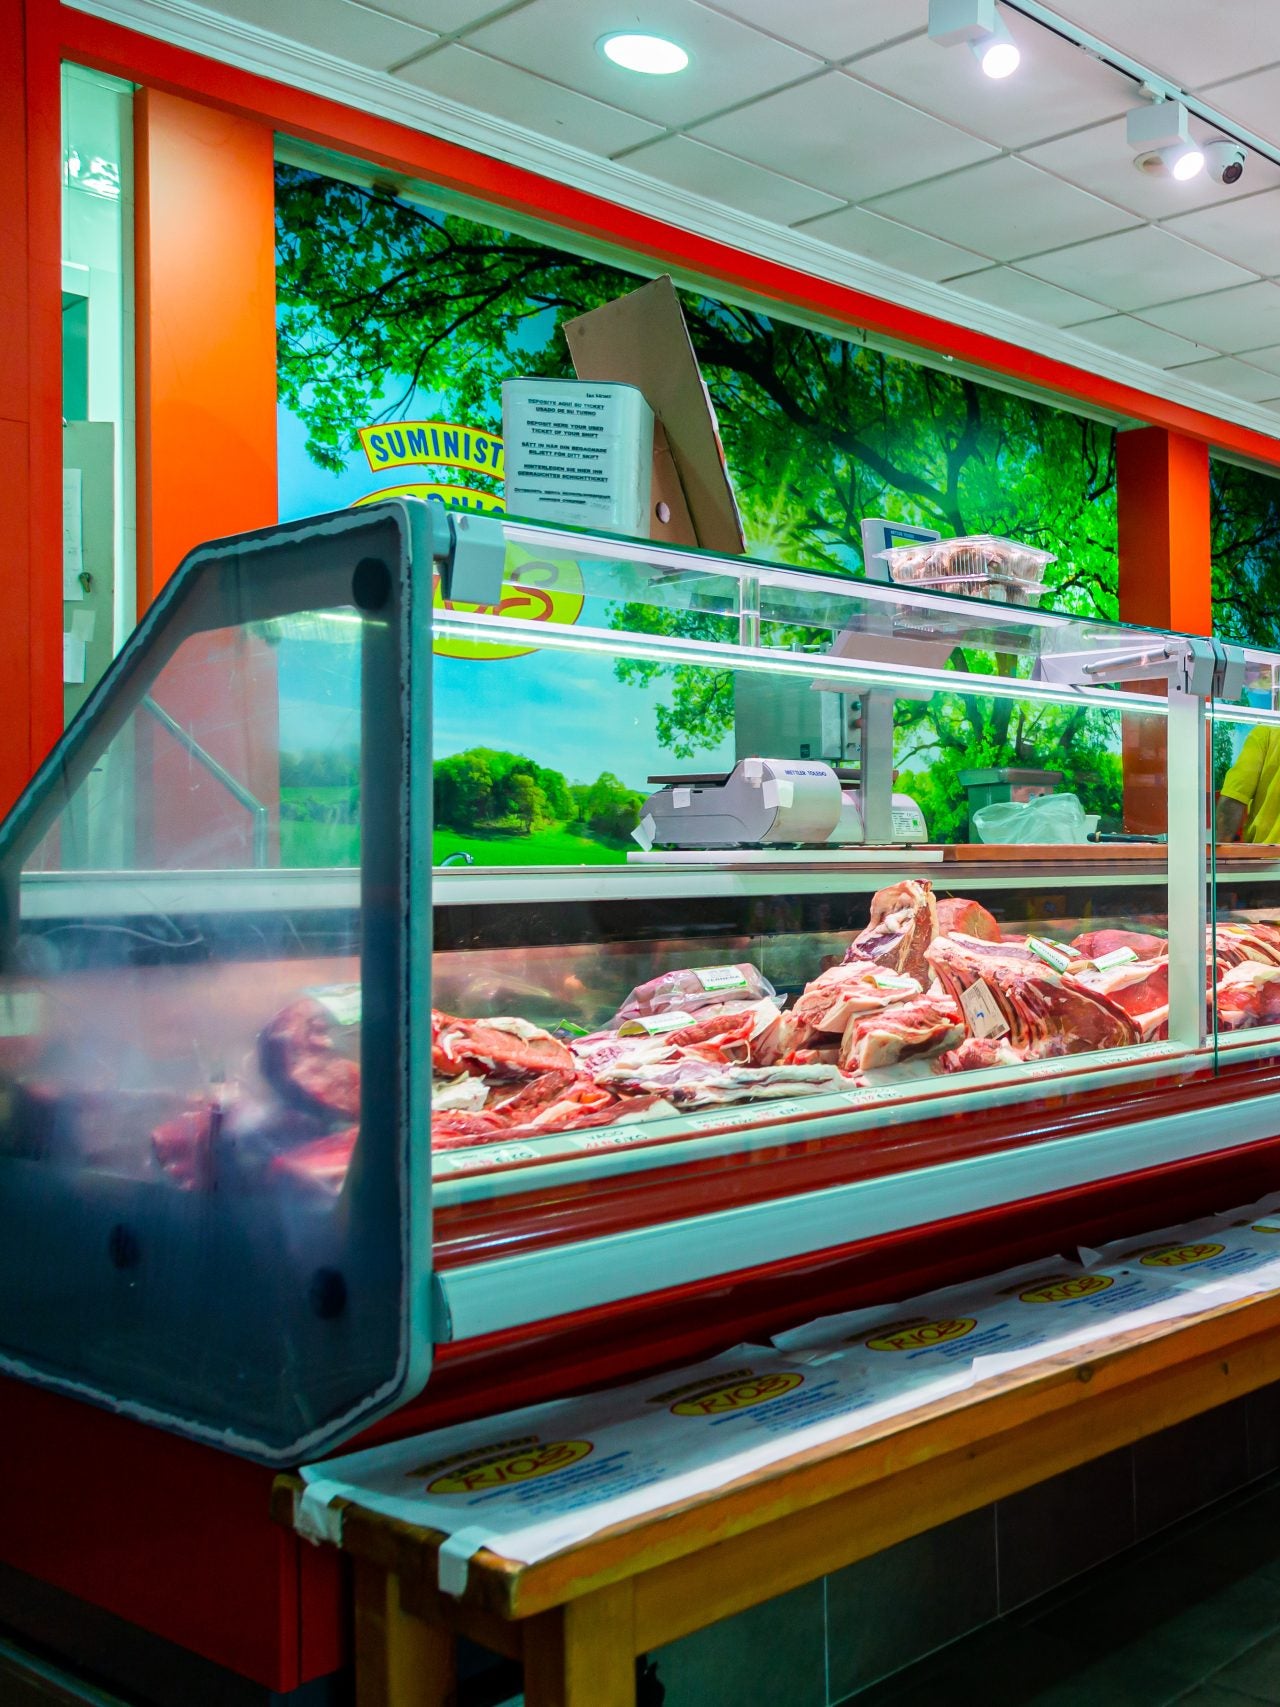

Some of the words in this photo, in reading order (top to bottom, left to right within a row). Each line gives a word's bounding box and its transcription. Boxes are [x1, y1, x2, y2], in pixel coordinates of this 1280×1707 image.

[370, 428, 504, 469] SUMINIST
[524, 464, 564, 472] HINTERLEGEN
[1155, 1244, 1216, 1266] RIOS
[1036, 1277, 1104, 1301] RIOS
[885, 1320, 966, 1350] RIOS
[694, 1376, 791, 1414] RIOS
[458, 1444, 576, 1491] RIOS
